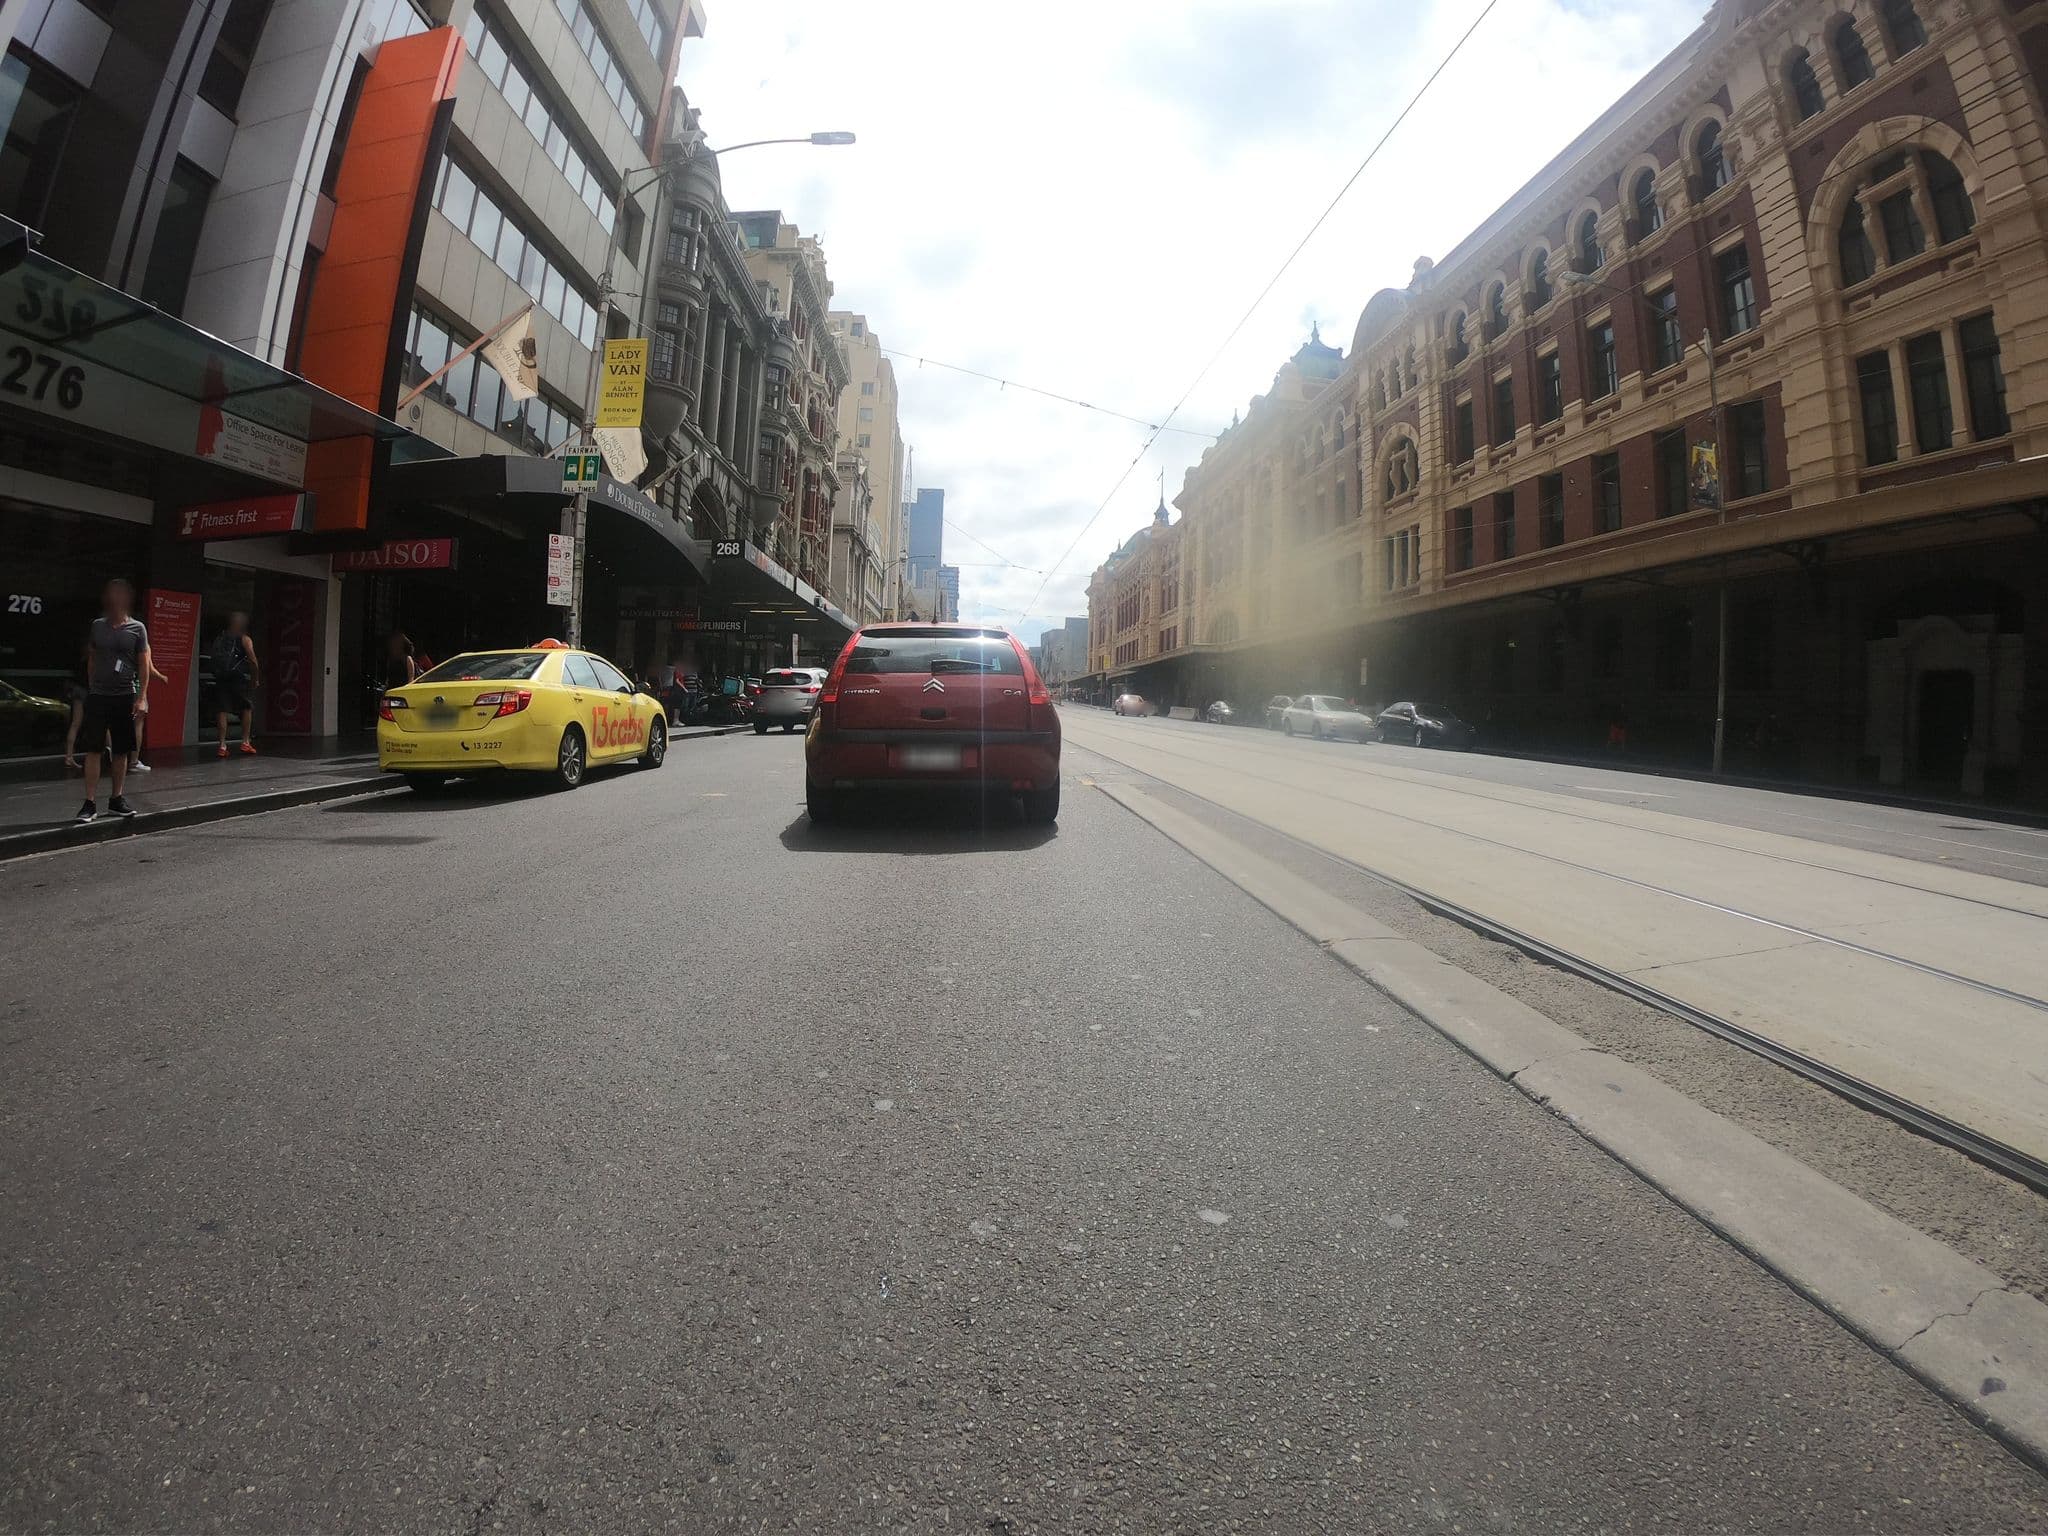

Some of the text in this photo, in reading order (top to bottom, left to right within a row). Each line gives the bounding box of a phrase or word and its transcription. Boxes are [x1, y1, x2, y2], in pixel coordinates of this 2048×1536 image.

[611, 350, 641, 360] LADY
[1, 346, 86, 410] 276
[609, 365, 641, 376] VAN
[225, 417, 250, 435] Office
[250, 426, 273, 443] Space
[273, 435, 287, 448] For
[286, 441, 306, 456] Lease
[568, 447, 599, 455] FAIRWAY
[350, 543, 430, 566] DAISO
[716, 542, 740, 556] 268
[8, 594, 42, 615] 276
[592, 706, 644, 748] 13cabs
[473, 741, 503, 750] 13 2227
